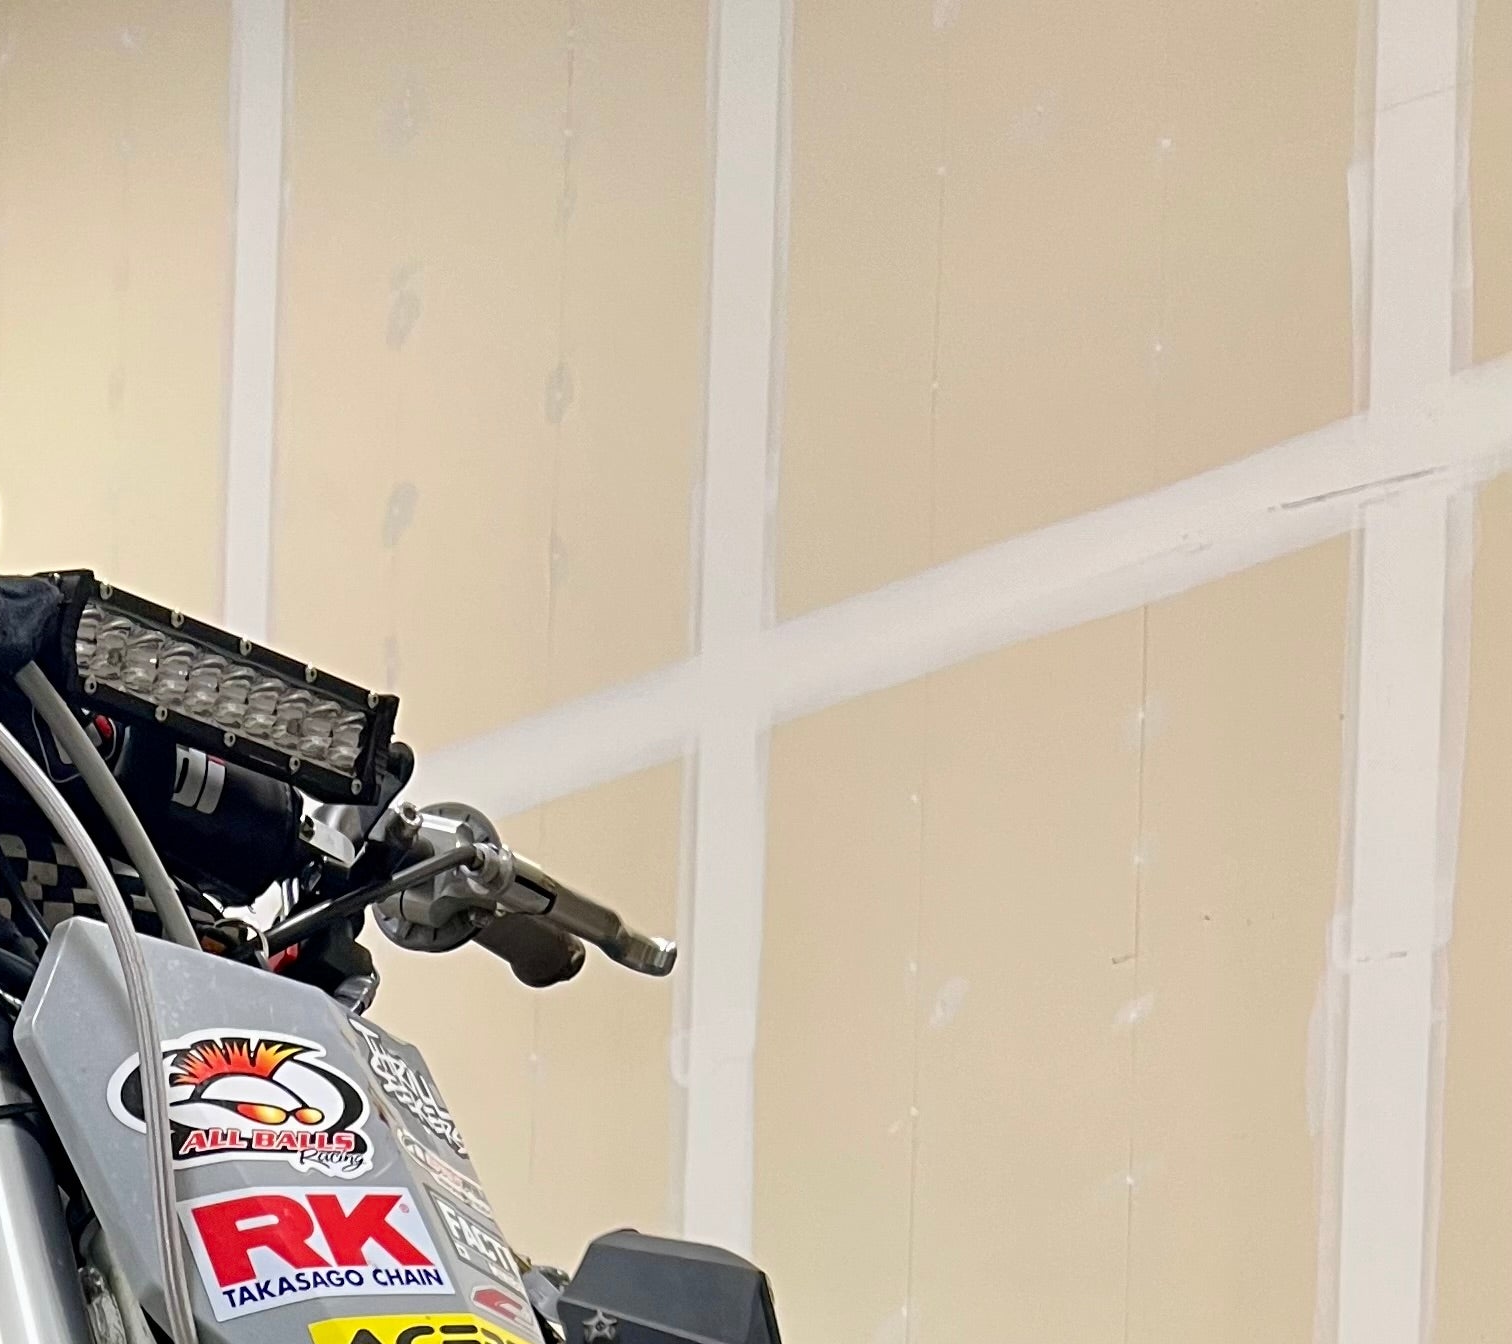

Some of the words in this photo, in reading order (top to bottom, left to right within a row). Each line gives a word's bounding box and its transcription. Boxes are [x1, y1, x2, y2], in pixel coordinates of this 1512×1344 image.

[181, 1129, 247, 1153] ALL
[250, 1130, 355, 1152] BALLS
[298, 1147, 366, 1173] Racing
[191, 1193, 435, 1289] RK
[222, 1268, 364, 1308] TAKASAGO
[372, 1267, 445, 1288] CHAIN
